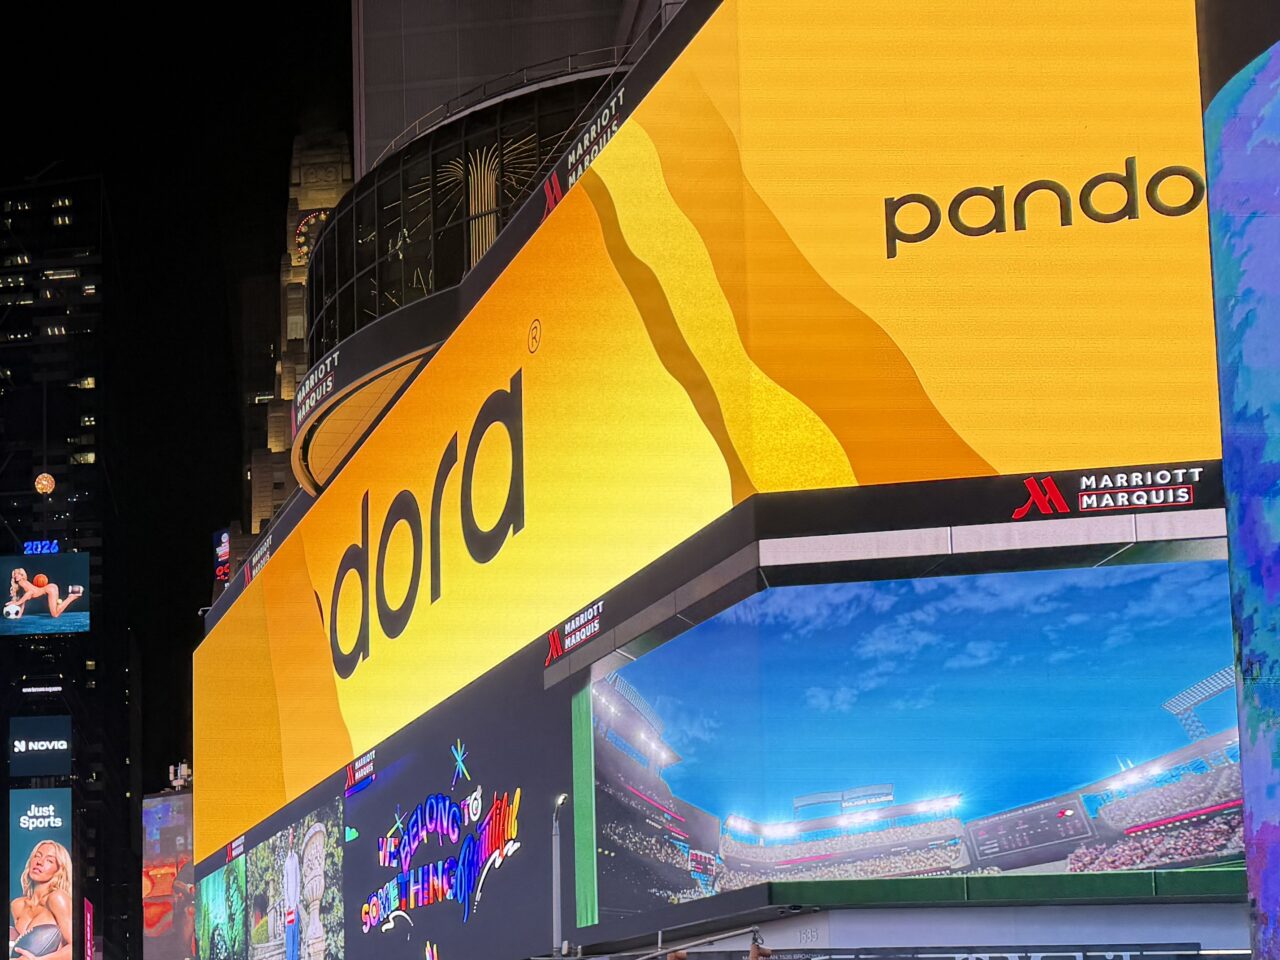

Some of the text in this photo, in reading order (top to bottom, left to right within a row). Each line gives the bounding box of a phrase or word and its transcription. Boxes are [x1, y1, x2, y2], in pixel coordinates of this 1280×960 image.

[568, 87, 625, 169] MARRIOTT
[884, 156, 1206, 259] pando
[297, 351, 340, 406] MARRIOTT
[297, 376, 334, 425] MARQUIS
[1080, 467, 1204, 490] MARRIOTT
[1081, 488, 1190, 508] MARQUIS
[314, 367, 525, 679] dora
[24, 539, 59, 554] 2026
[565, 600, 604, 635] MARRIOTT
[564, 620, 600, 649] MARQUIS
[28, 740, 68, 750] NOVIG
[355, 750, 376, 770] MARRIOTT
[19, 816, 63, 830] Sports
[27, 804, 55, 816] Just
[379, 785, 483, 875] WE BELONG TO
[361, 857, 458, 934] SOMETHING
